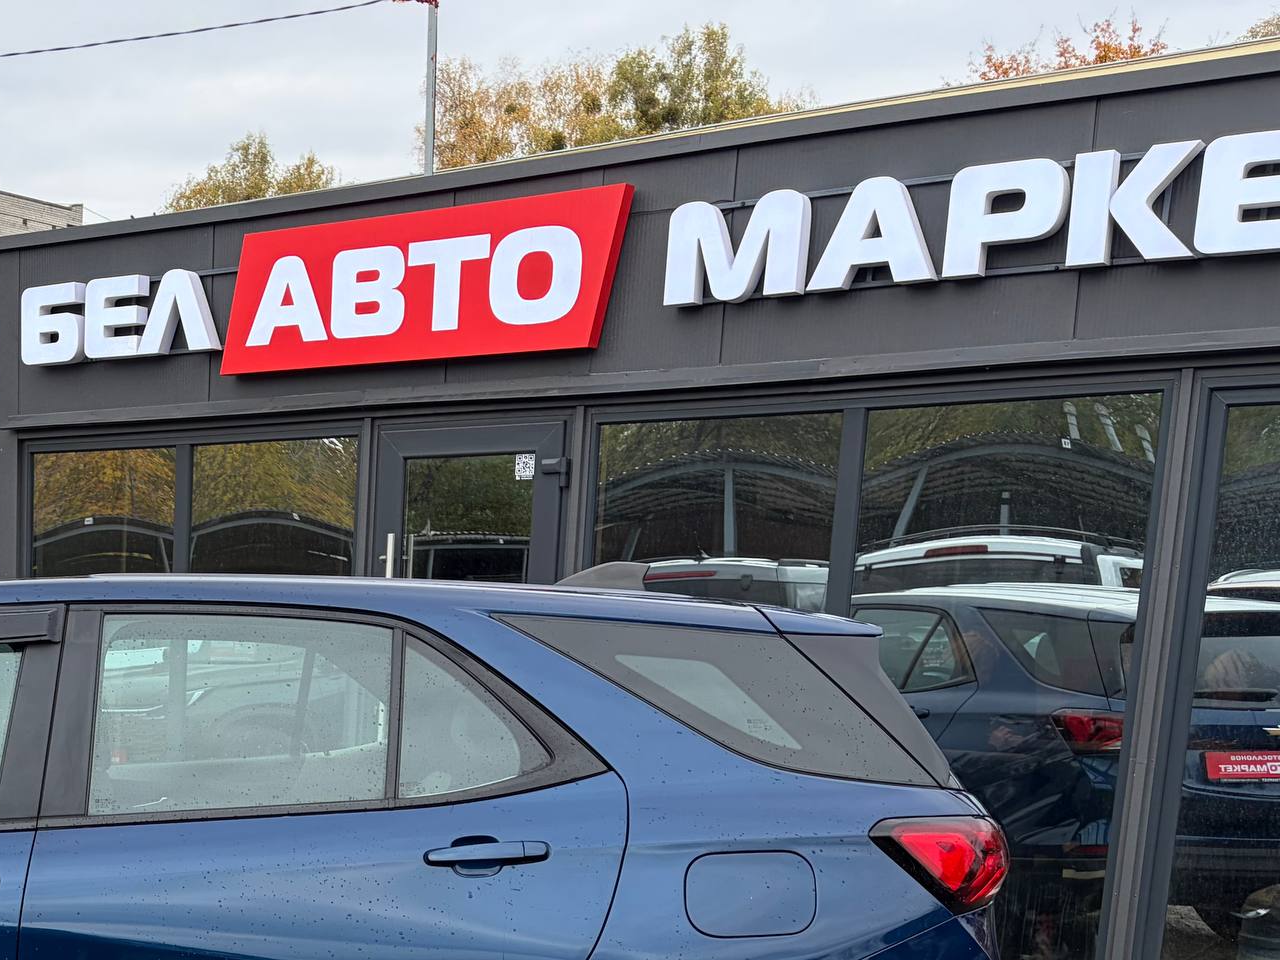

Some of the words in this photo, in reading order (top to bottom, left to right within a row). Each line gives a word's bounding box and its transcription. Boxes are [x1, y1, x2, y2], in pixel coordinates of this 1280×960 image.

[21, 268, 222, 366] БЕЛ
[245, 225, 583, 347] АВТО
[663, 129, 1280, 306] МАРКЕ
